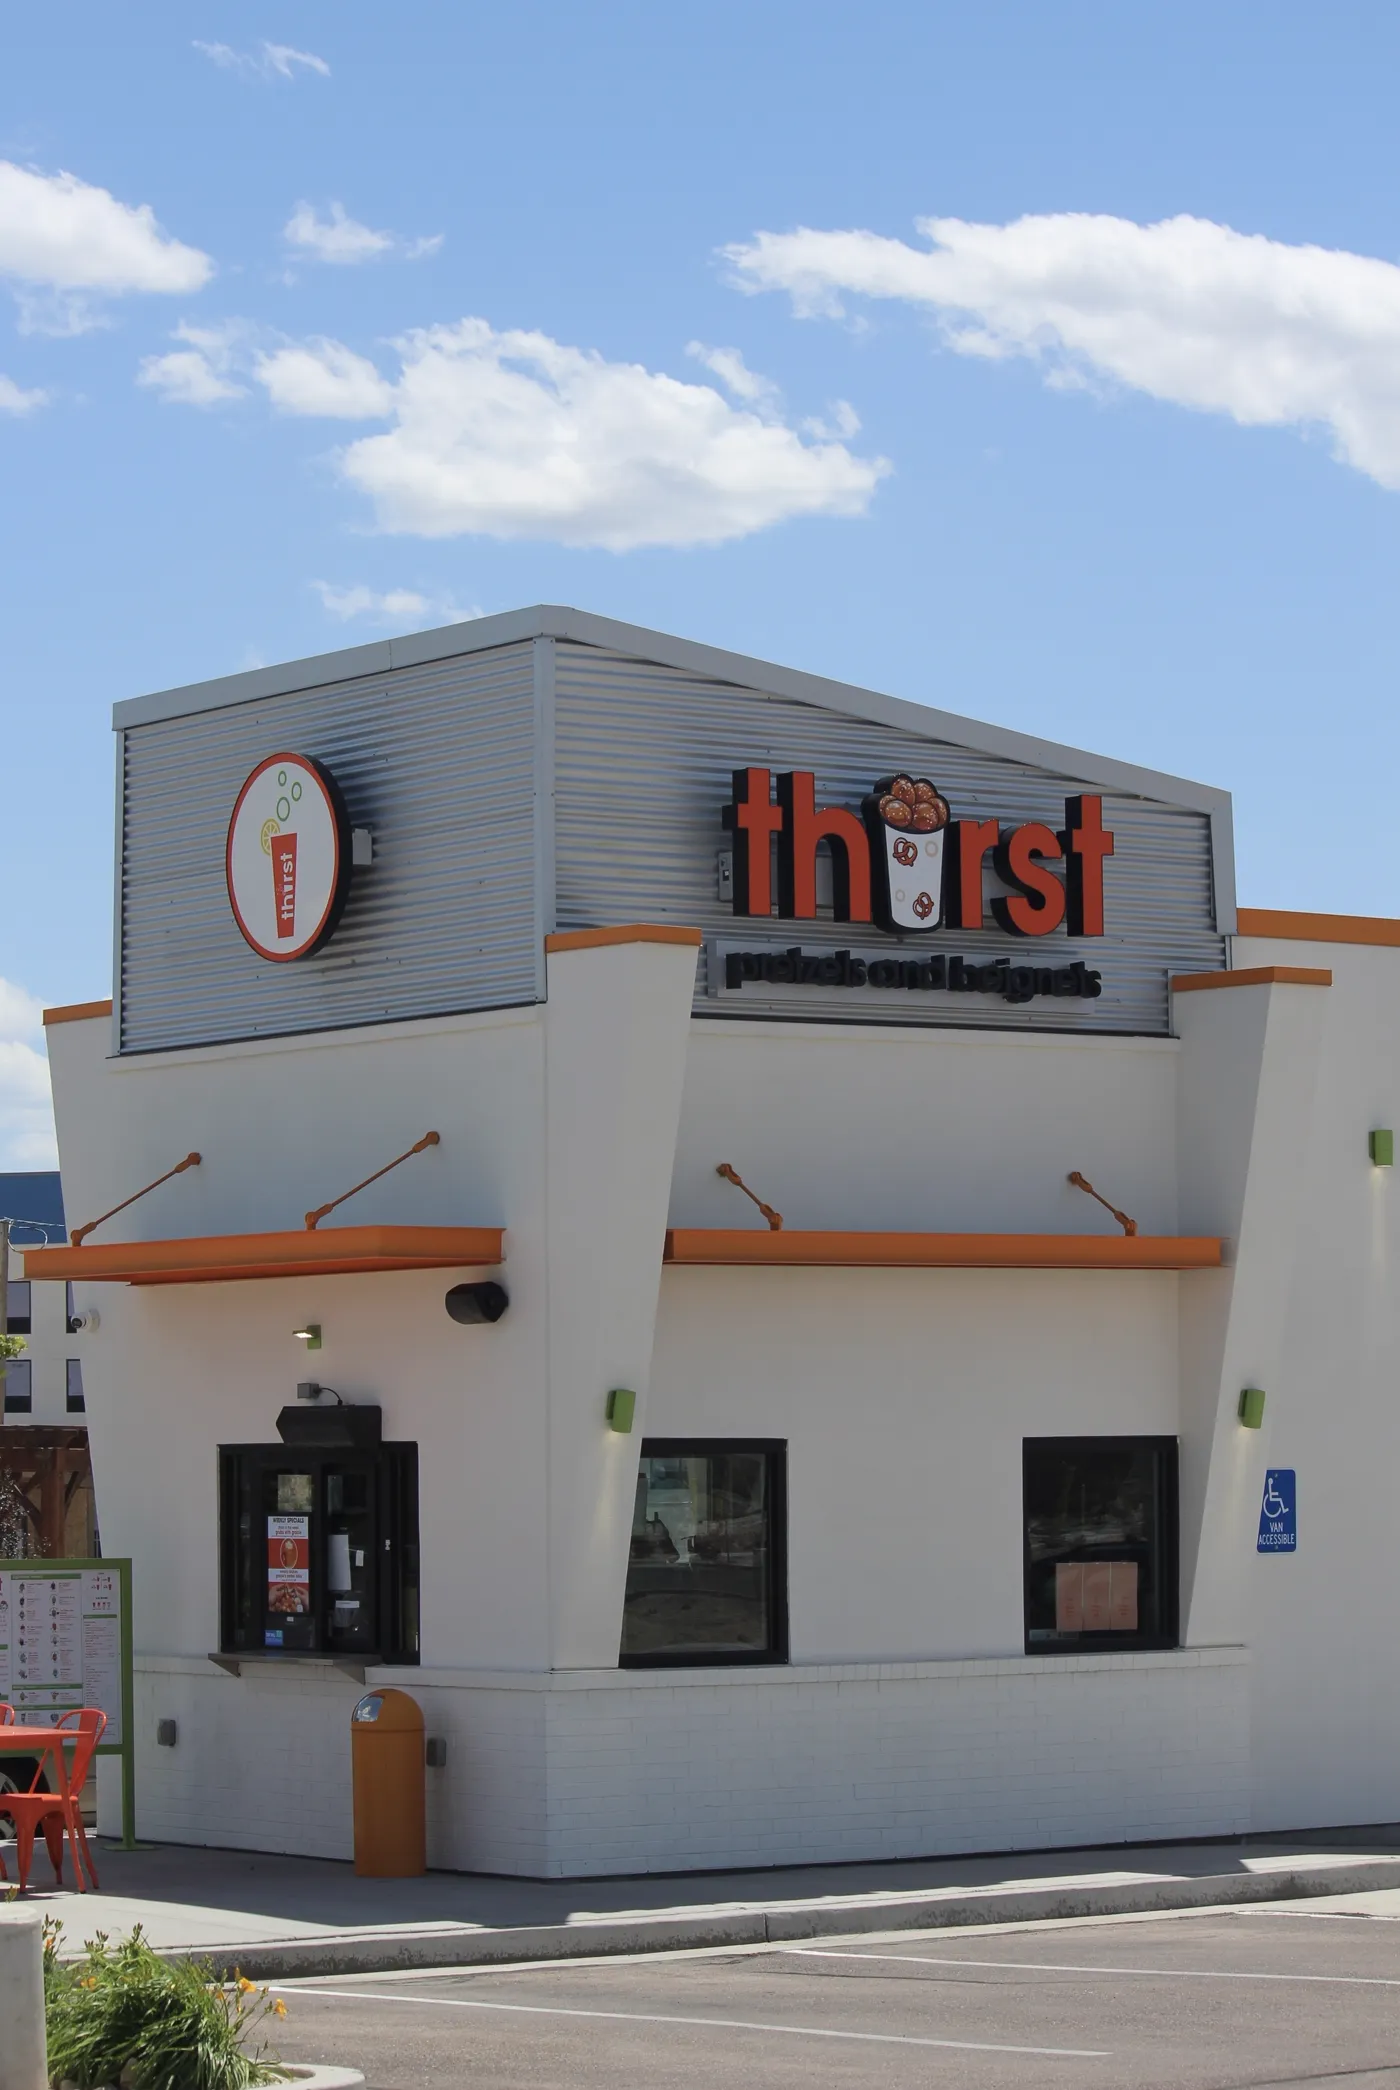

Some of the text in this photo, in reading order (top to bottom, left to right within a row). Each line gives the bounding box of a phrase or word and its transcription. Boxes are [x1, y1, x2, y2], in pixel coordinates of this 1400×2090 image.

[726, 946, 1102, 1003] pretzels and beignets
[1269, 1521, 1284, 1532] VAN
[1258, 1533, 1295, 1545] ACCESSIBLE
